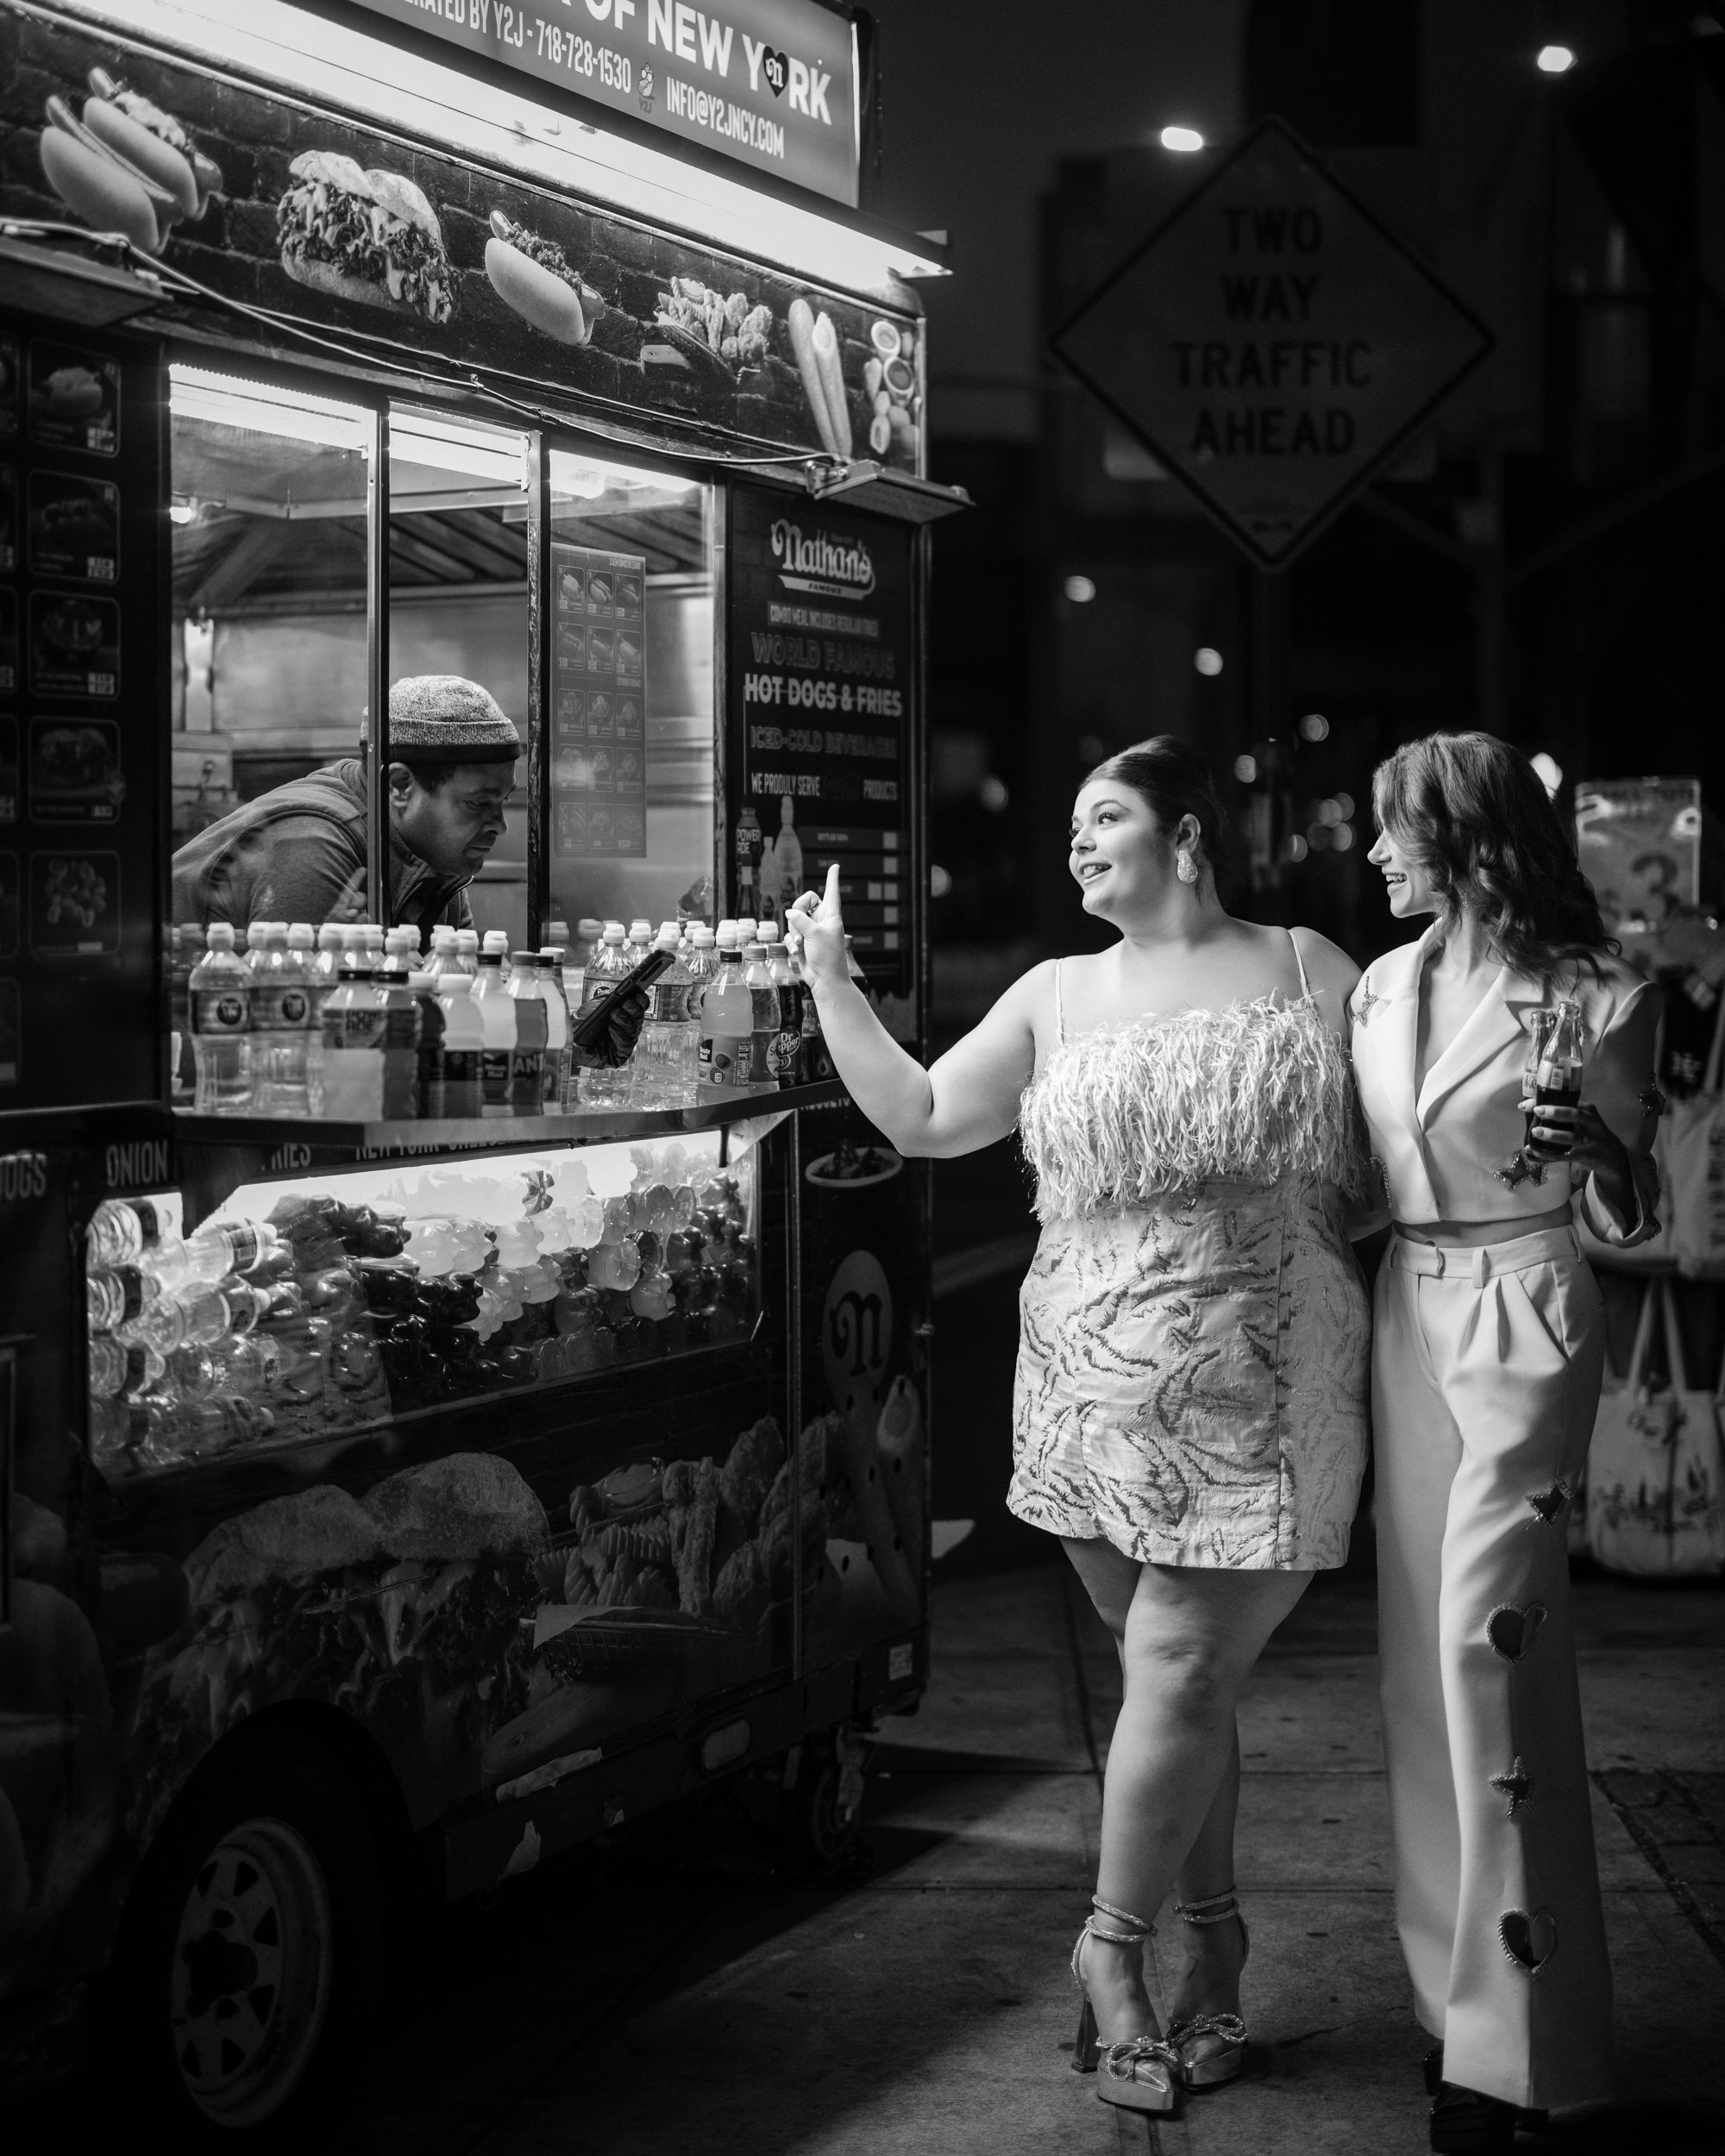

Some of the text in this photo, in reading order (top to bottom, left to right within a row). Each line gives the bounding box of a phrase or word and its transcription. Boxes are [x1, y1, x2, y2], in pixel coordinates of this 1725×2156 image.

[469, 0, 490, 34] BY
[493, 1, 524, 48] Y2J
[536, 18, 631, 93] 718-728-1530
[648, 0, 733, 78] NEW
[667, 76, 785, 159] INFO@Y2JNCY.COM
[1222, 207, 1324, 254] TWO
[1221, 273, 1320, 322] WAY
[1172, 342, 1371, 388] TRAFFIC
[1191, 407, 1356, 457] AHEAD
[770, 518, 872, 584] Nathan's
[750, 632, 820, 668] WORLD
[744, 673, 903, 717] HOT DOGS & FRIES
[750, 725, 823, 753] ICED-COLD
[750, 773, 763, 794] WE
[797, 774, 821, 797] SERVE
[737, 828, 760, 842] POWER
[780, 1032, 794, 1044] Dr
[0, 1149, 47, 1200] OGS
[105, 1139, 168, 1188] ONION
